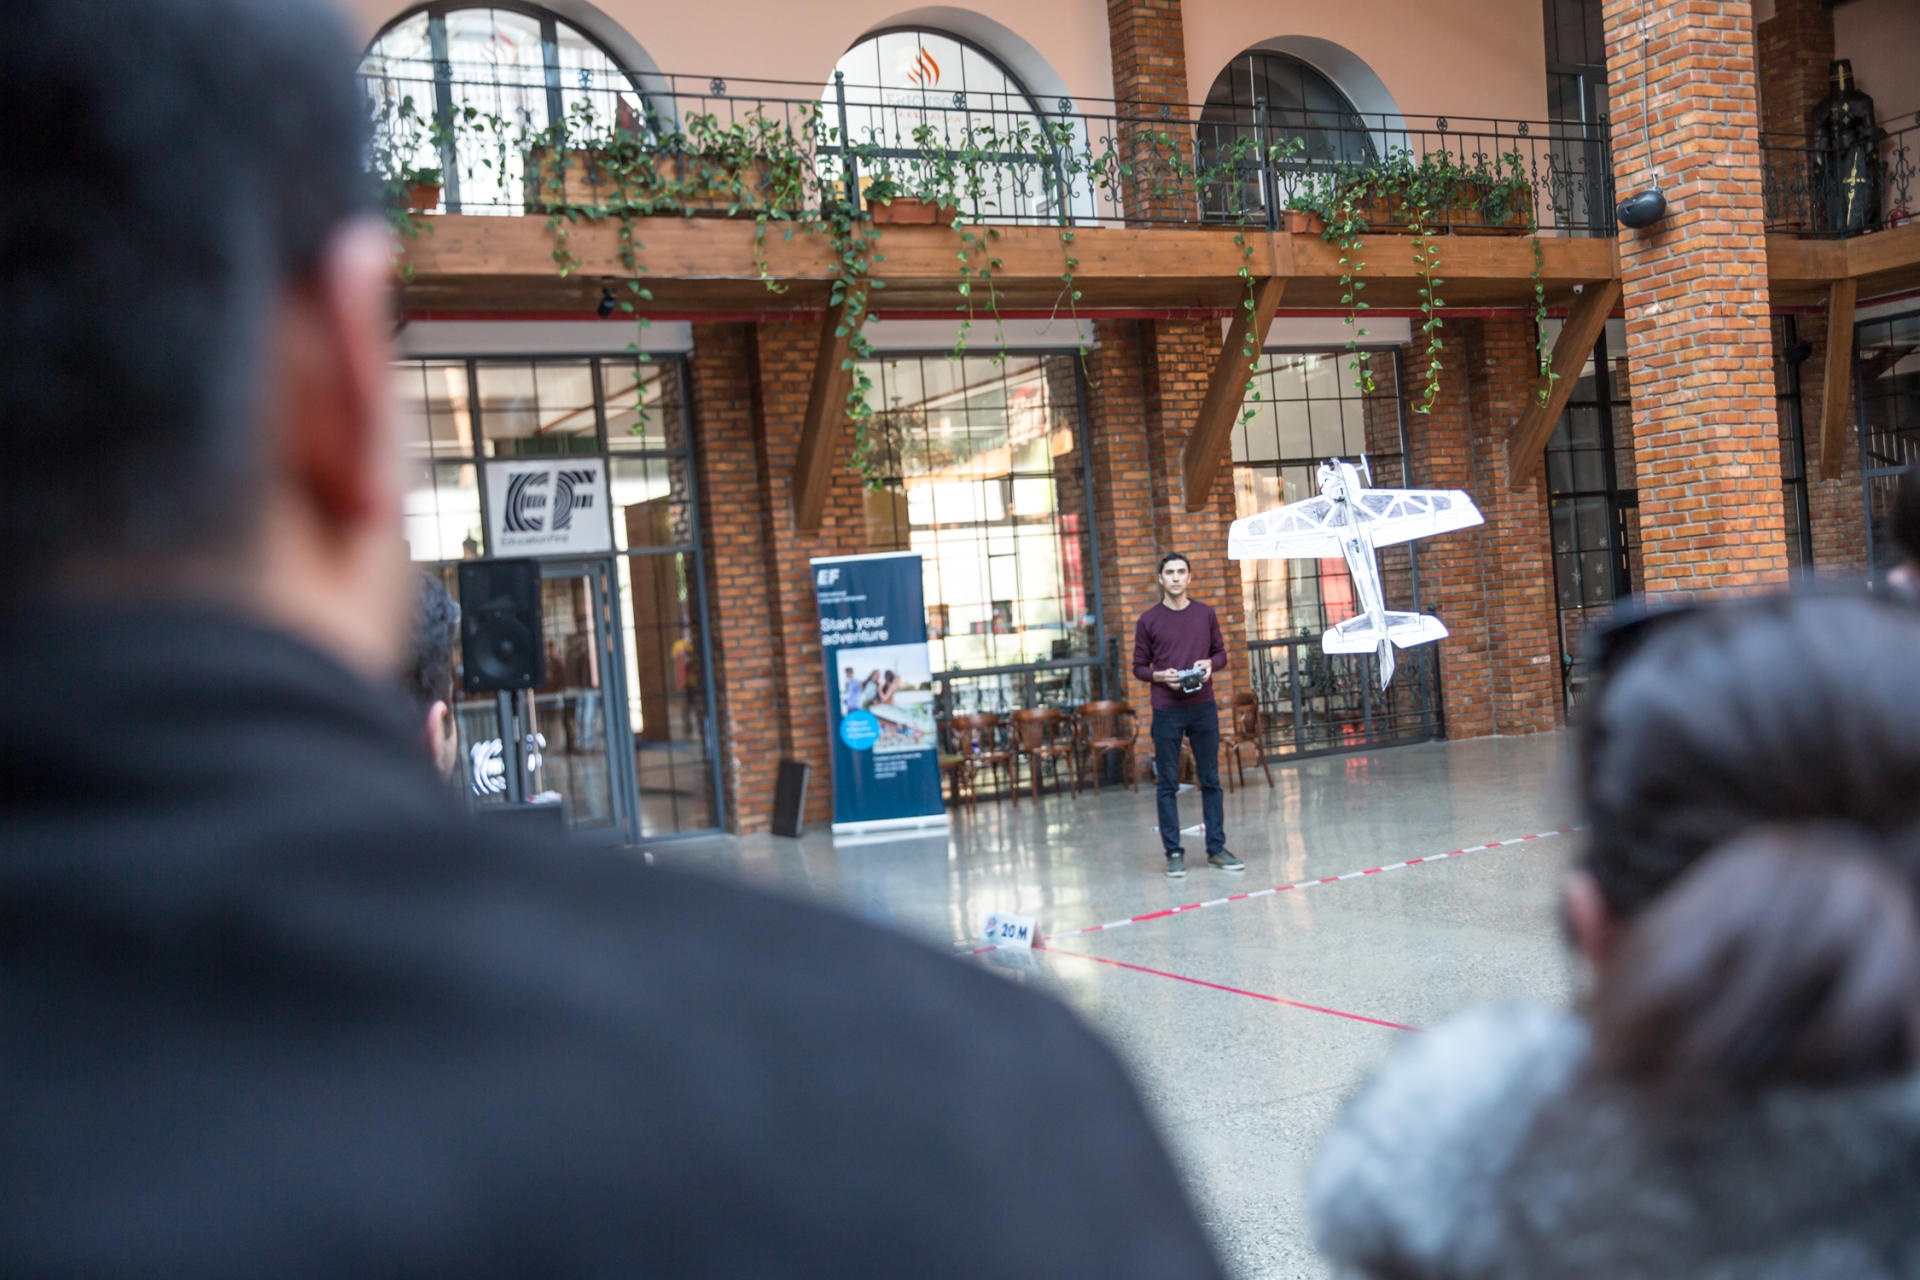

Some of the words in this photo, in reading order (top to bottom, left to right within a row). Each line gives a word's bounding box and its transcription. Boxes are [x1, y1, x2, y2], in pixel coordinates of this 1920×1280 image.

[503, 469, 596, 533] EF
[817, 568, 840, 586] EF
[820, 617, 854, 632] Start
[855, 616, 885, 632] your
[821, 630, 888, 646] adventure
[1001, 923, 1016, 938] 20
